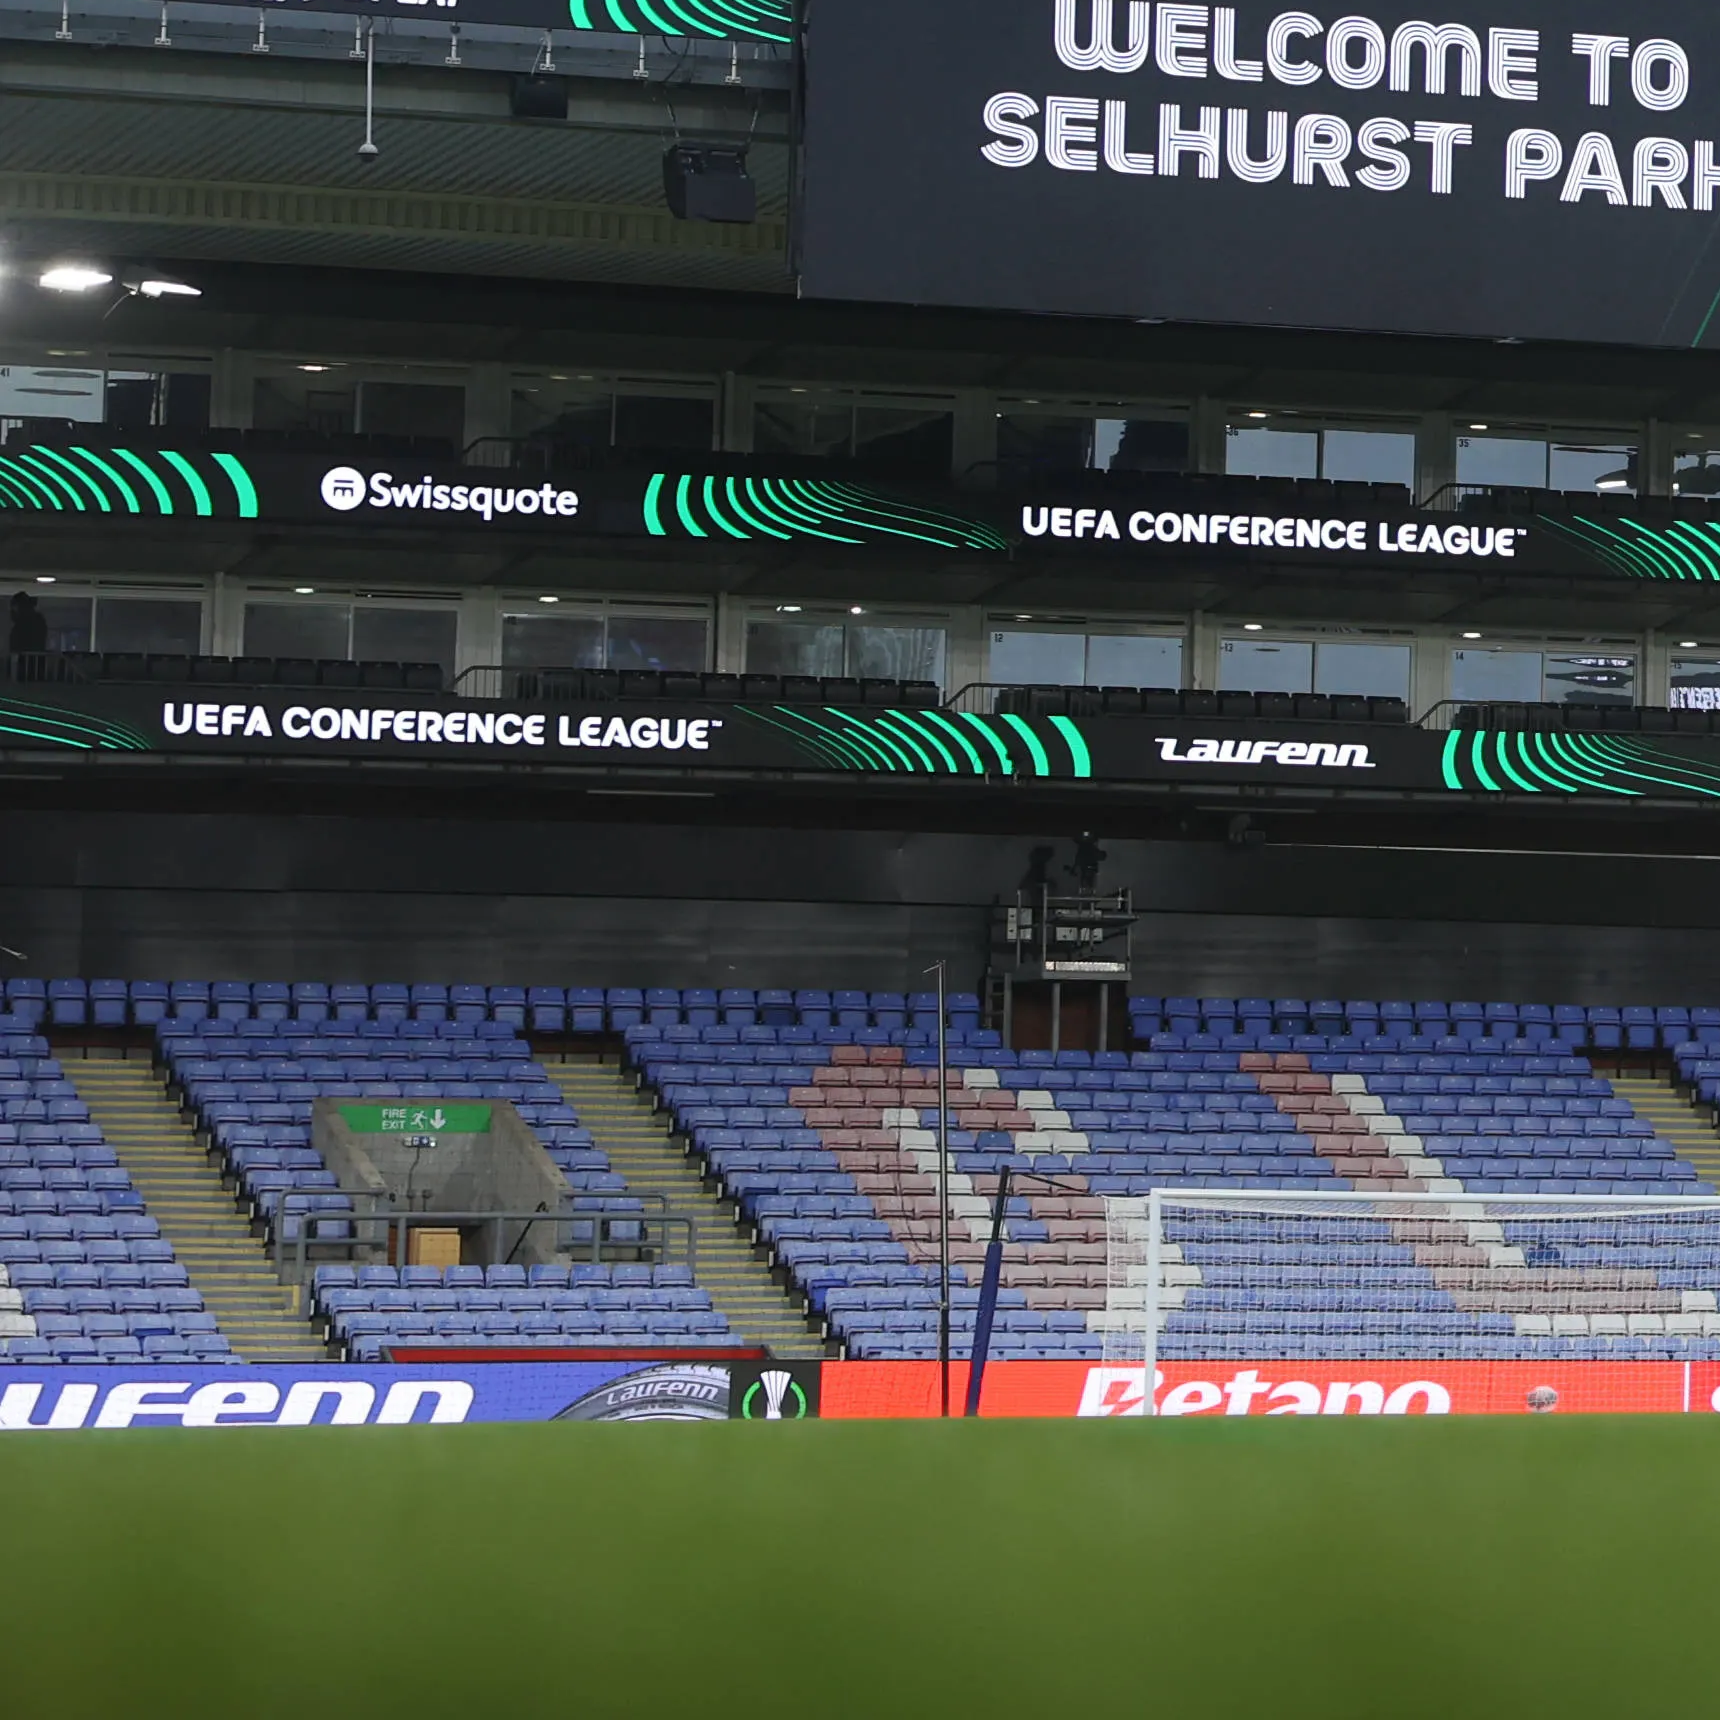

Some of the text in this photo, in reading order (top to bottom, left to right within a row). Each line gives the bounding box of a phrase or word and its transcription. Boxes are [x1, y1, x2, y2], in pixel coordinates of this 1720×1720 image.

[1571, 31, 1690, 113] TO
[980, 91, 1474, 196] SELHURST
[369, 471, 579, 521] Swissquote
[1022, 506, 1121, 540] UEFA
[1128, 511, 1367, 550] CONFERENCE
[163, 702, 273, 737] UEFA
[281, 706, 546, 745] CONFERENCE
[382, 1108, 407, 1119] FIRE
[382, 1120, 405, 1130] EXIT
[1076, 1367, 1451, 1417] Betano
